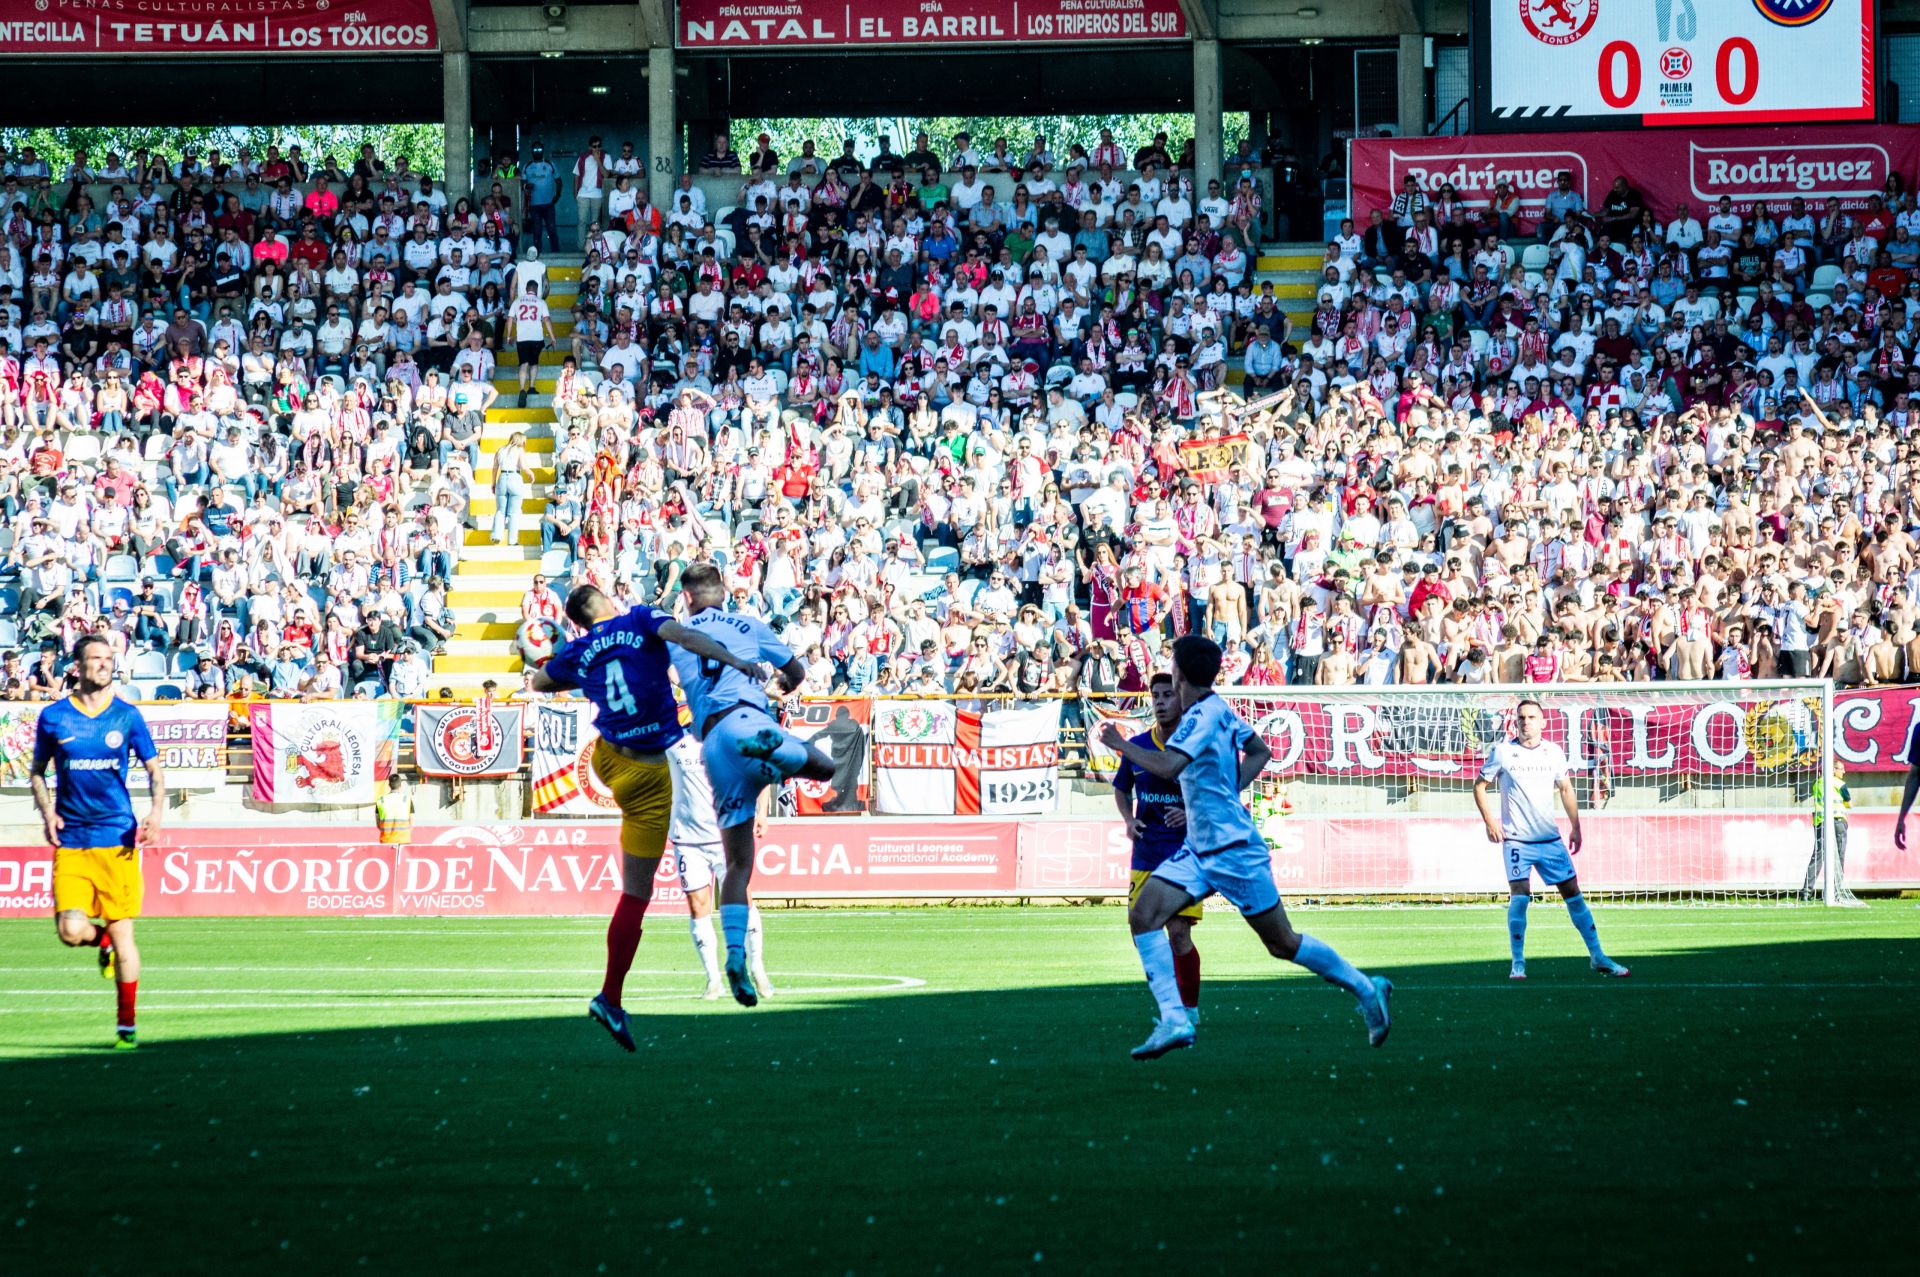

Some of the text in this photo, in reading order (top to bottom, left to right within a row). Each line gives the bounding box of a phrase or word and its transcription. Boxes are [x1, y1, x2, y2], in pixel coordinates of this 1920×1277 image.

[138, 0, 305, 11] CULTURALISTAS
[719, 5, 803, 16] PEÑA CULTURALISTA
[921, 2, 942, 12] PEÑA
[1084, 0, 1144, 9] CULTURALISTA
[344, 11, 366, 22] PEÑA
[860, 16, 1004, 38] EL BARRIL
[1027, 12, 1177, 35] LOS TRIPEROS DEL SUR
[111, 20, 255, 42] TETUÁN
[278, 23, 429, 46] LOS TÓXICOS
[687, 18, 835, 41] NATAL
[1537, 31, 1581, 45] LEONESA
[1598, 40, 1641, 108] 0
[1716, 37, 1759, 105] 0
[1660, 83, 1692, 92] PRIMERA
[1708, 155, 1872, 190] Rodríguez
[519, 304, 538, 321] 23
[580, 630, 643, 666] TRIGUEROS
[605, 658, 638, 716] 4
[301, 719, 362, 776] CULTURAL LEONESA
[879, 743, 1057, 768] CULTURALISTAS
[988, 779, 1055, 804] 1923
[868, 843, 964, 853] Cultural Leonesa
[868, 853, 999, 865] International Academy.
[1511, 848, 1520, 863] 5
[160, 849, 390, 895] SEÑORÍO
[403, 856, 473, 893] DE
[307, 895, 385, 909] BODEGAS
[413, 892, 485, 908] VIÑEDOS
